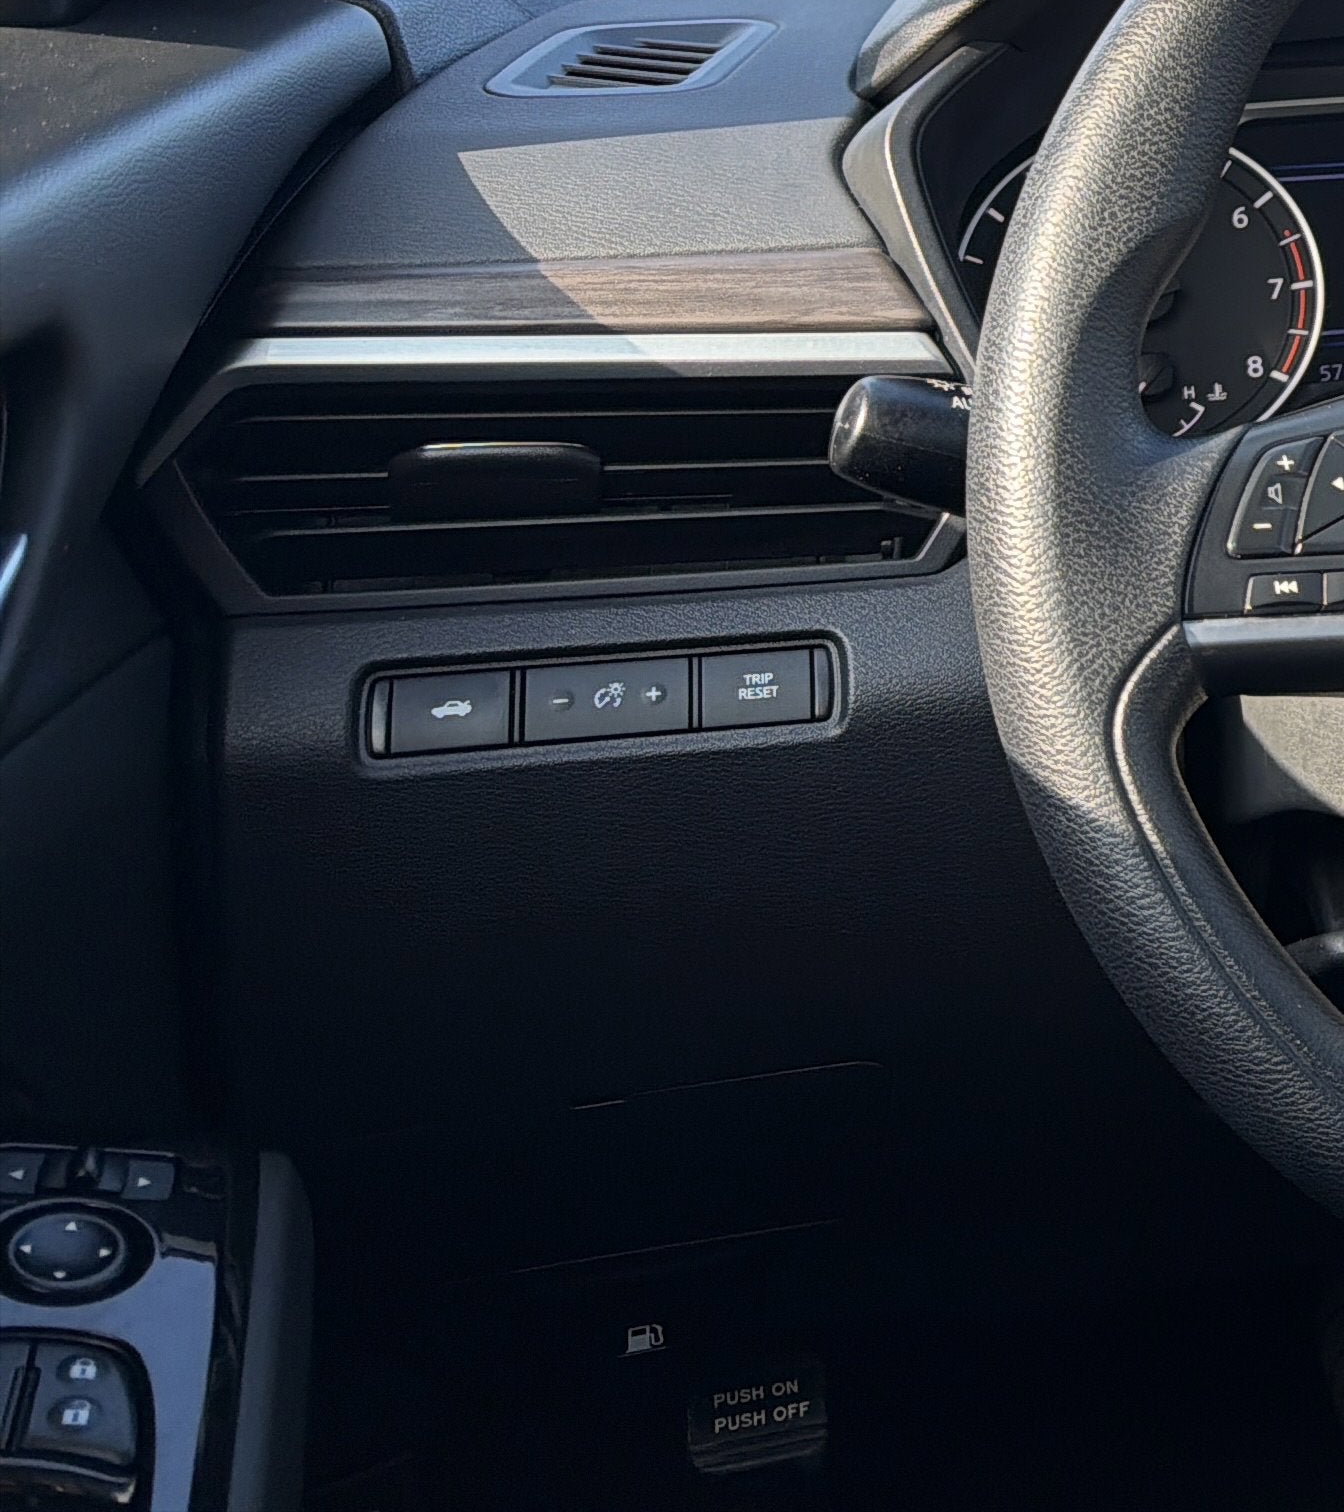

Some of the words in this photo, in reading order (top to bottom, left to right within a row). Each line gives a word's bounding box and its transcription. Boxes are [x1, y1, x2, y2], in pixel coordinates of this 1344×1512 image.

[1231, 205, 1250, 230] 6
[1266, 276, 1285, 301] 7
[1246, 354, 1265, 379] 8
[1183, 385, 1196, 400] H
[743, 672, 774, 685] TRIP
[738, 686, 779, 699] RESET
[713, 1385, 765, 1409] PUSH
[770, 1378, 800, 1397] ON
[713, 1408, 767, 1434] PUSH
[772, 1400, 811, 1423] OFF
